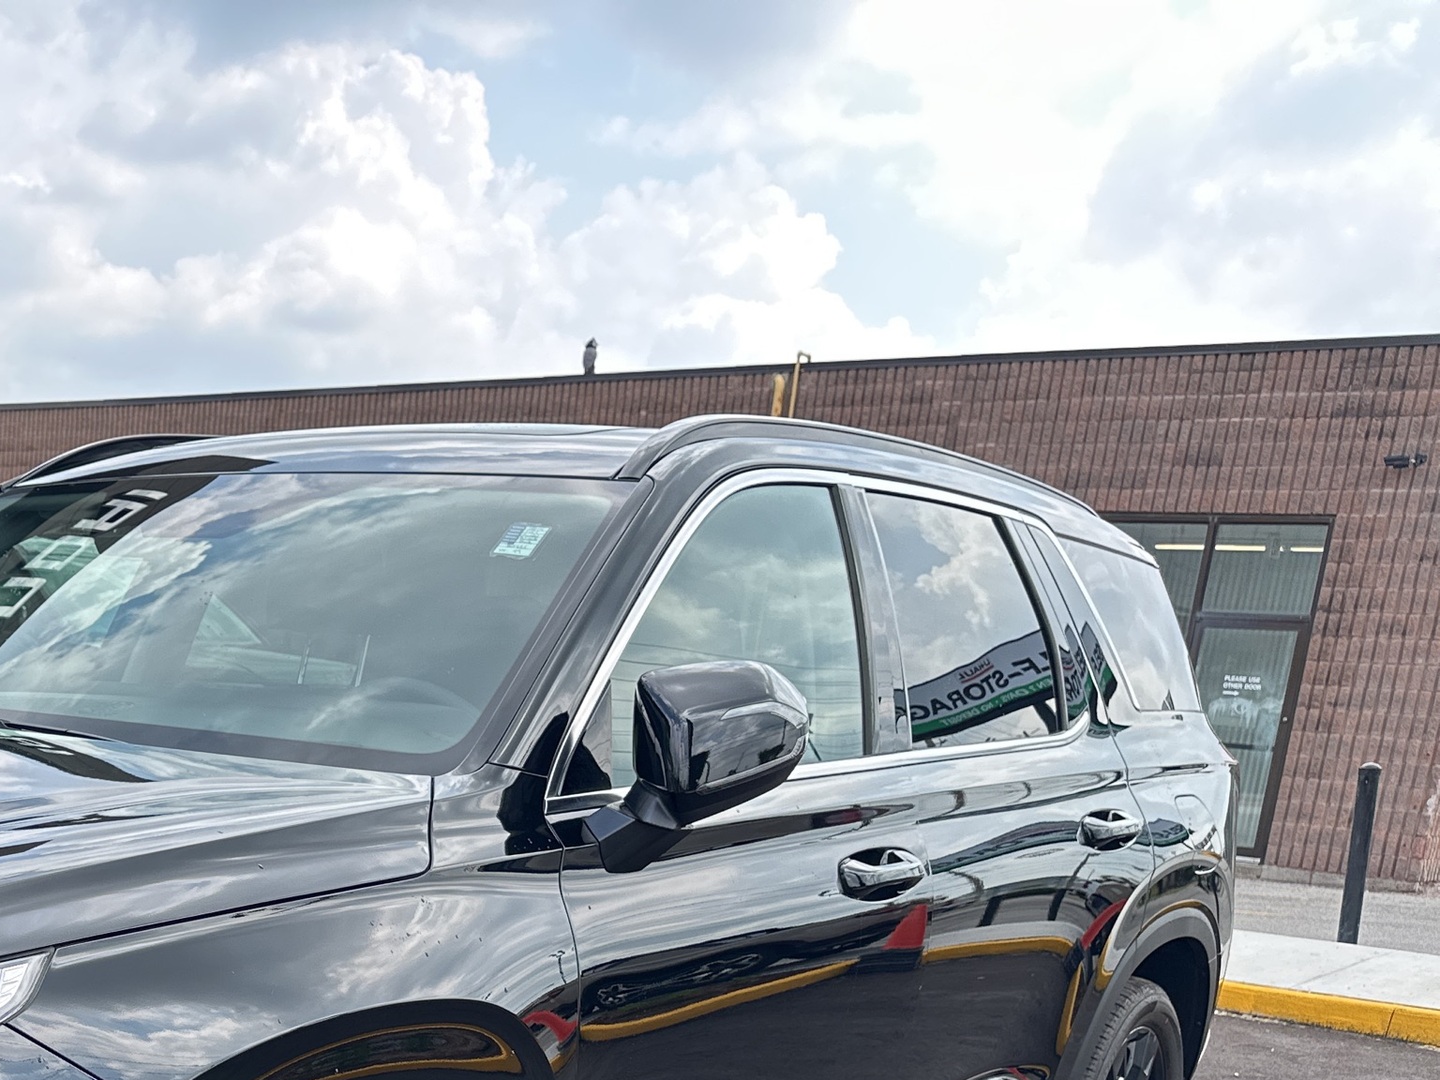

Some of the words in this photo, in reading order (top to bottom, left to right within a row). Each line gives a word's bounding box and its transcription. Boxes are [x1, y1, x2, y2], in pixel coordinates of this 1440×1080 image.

[1224, 674, 1247, 683] PLEASE
[1222, 682, 1243, 690] OTHER
[1244, 683, 1262, 691] DOOR
